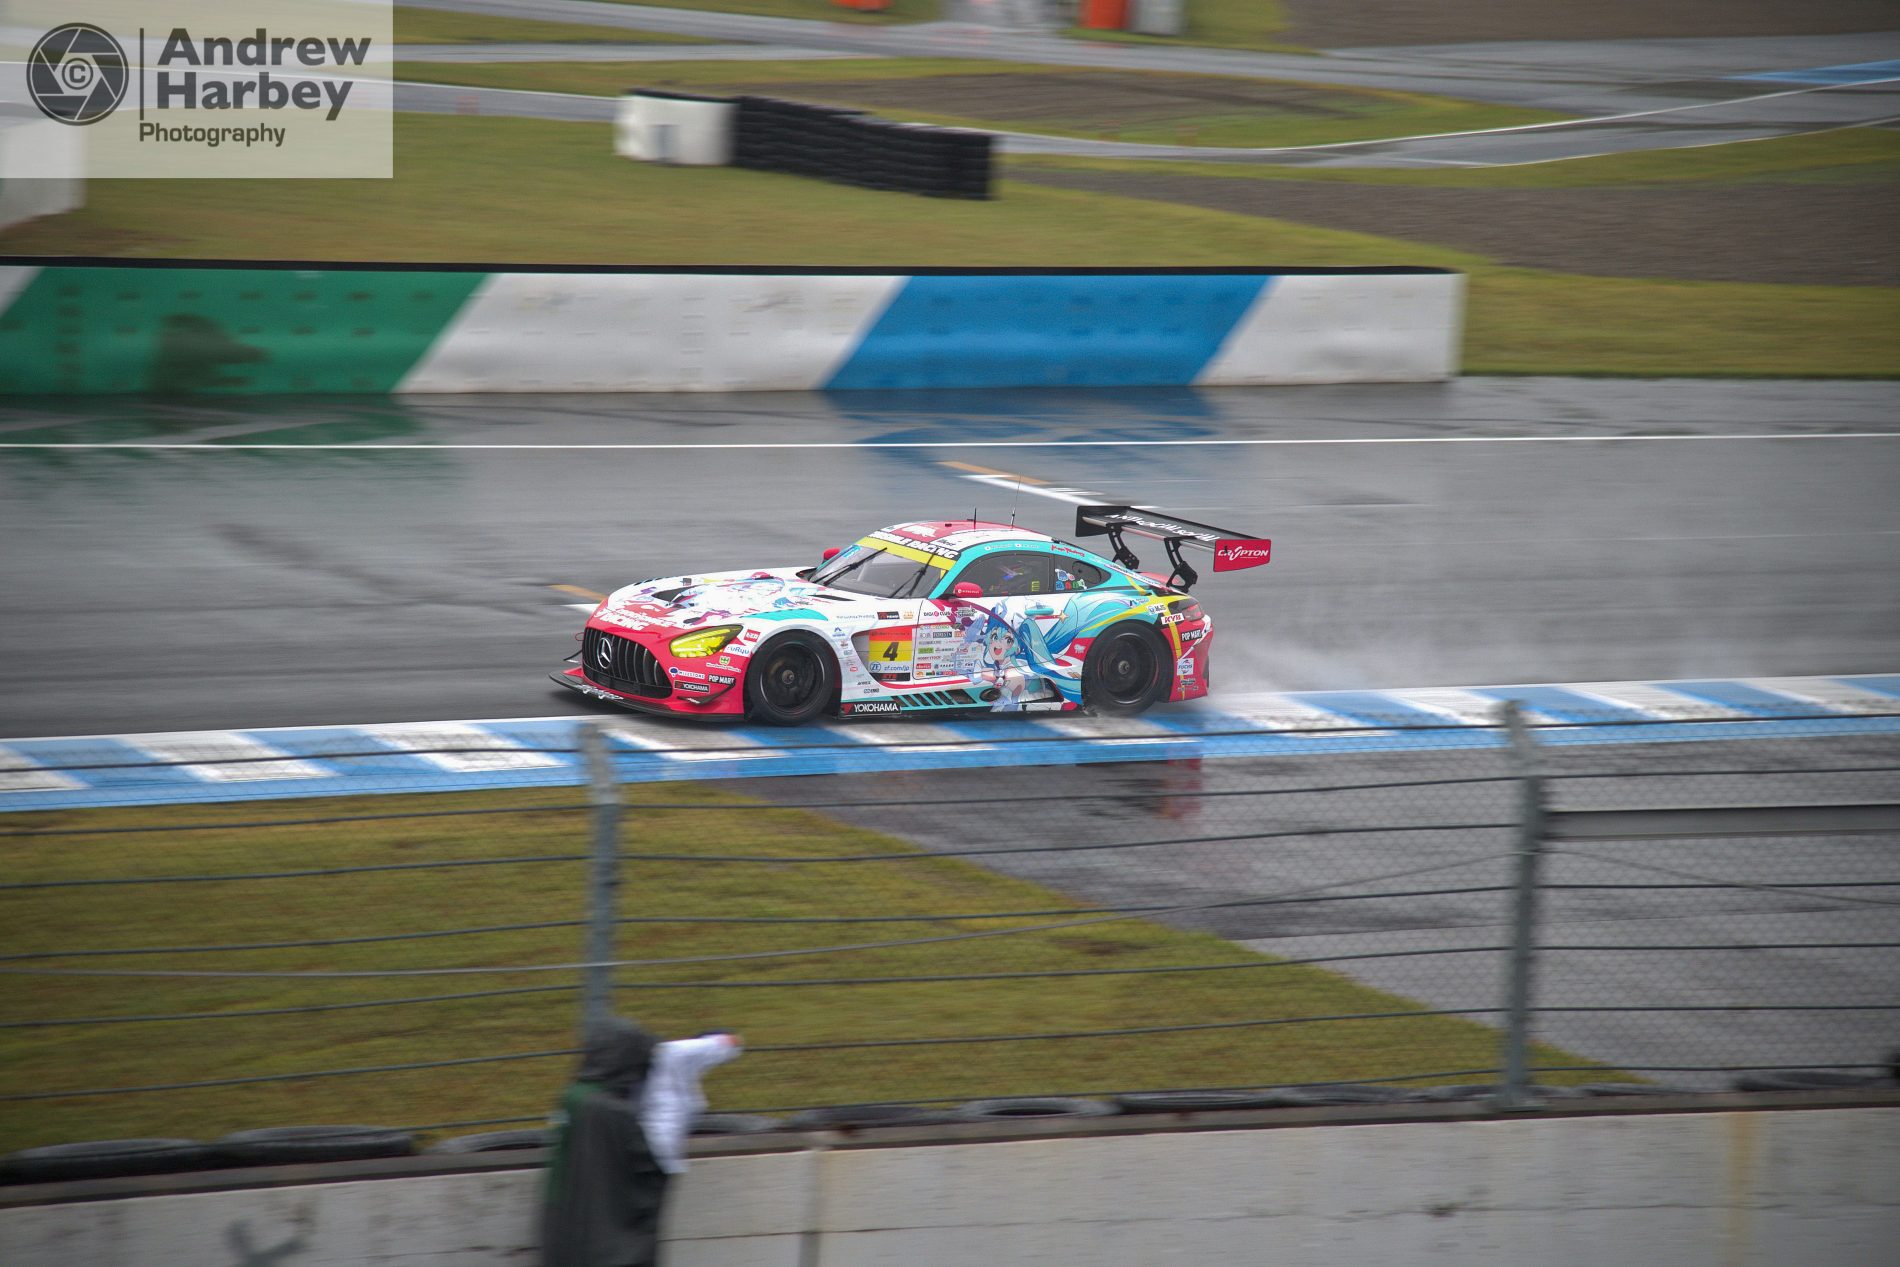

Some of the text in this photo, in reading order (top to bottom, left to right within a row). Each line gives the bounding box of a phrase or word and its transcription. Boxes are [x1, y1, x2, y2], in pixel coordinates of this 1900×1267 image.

[1217, 546, 1268, 561] CRYPTON
[1164, 614, 1182, 623] KYB
[1181, 632, 1190, 641] POP
[882, 642, 899, 661] 4
[871, 663, 880, 671] ZF
[708, 674, 735, 684] POP MART
[683, 682, 709, 692] YOKOHAMA
[853, 702, 899, 713] YOKOHAMA
